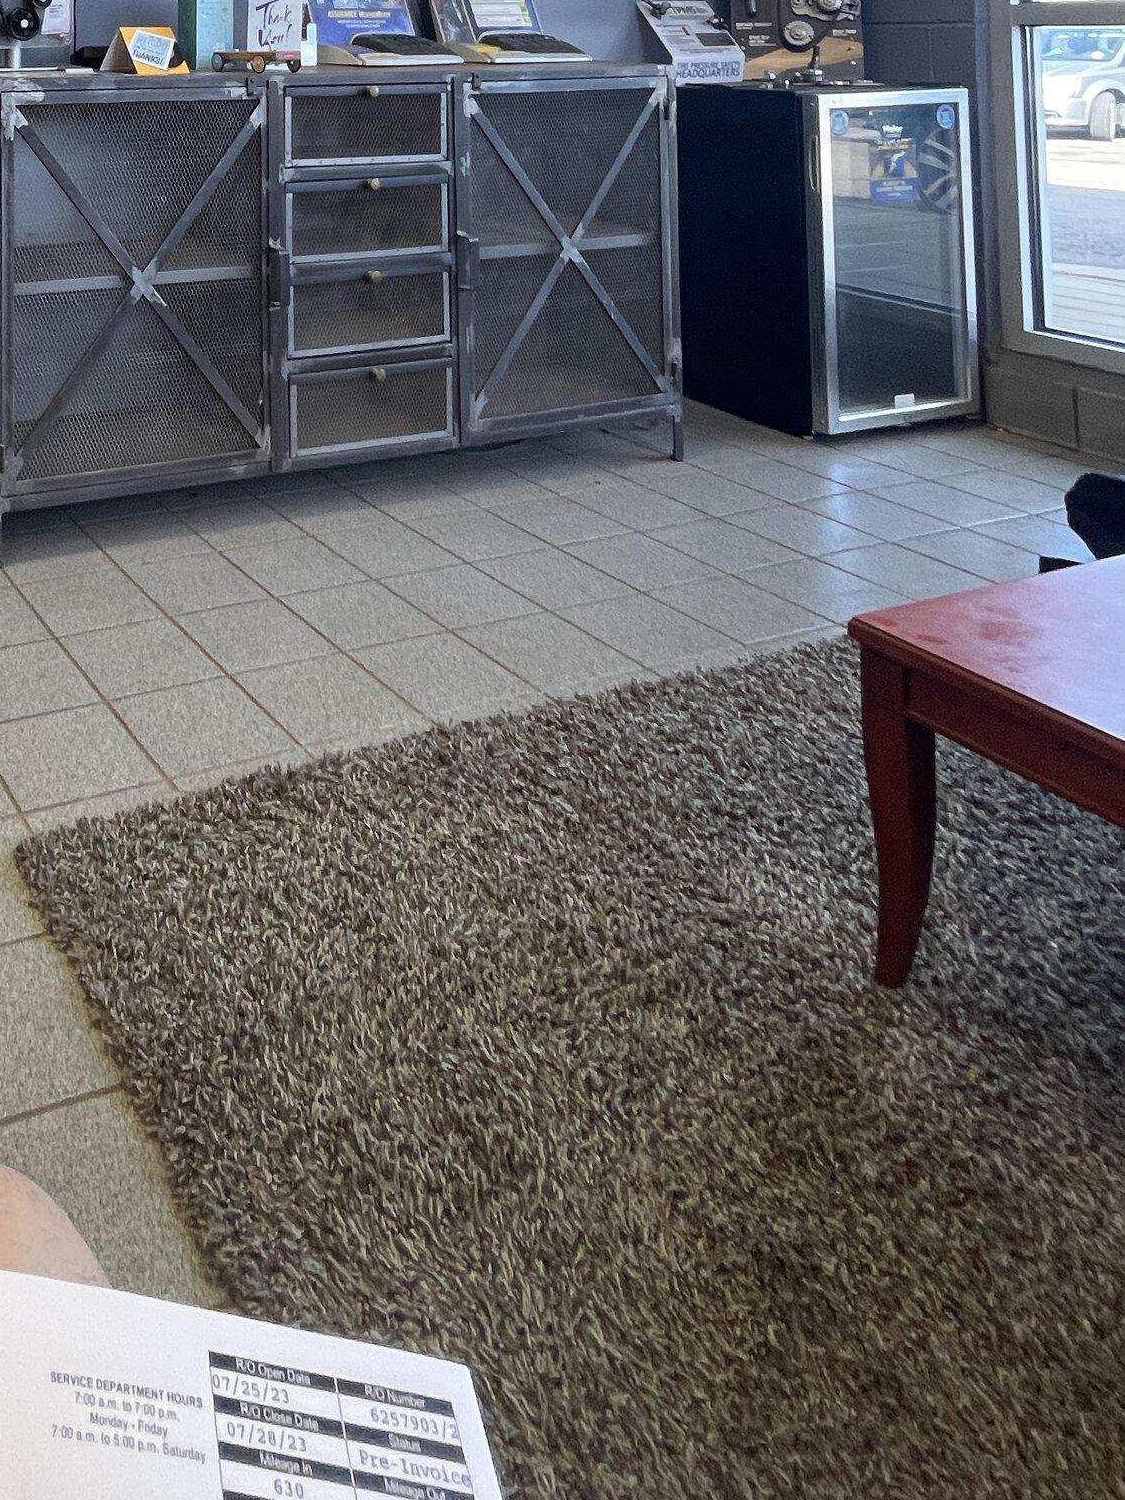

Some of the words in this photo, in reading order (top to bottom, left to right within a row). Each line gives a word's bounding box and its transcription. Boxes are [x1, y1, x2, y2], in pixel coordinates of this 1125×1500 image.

[675, 67, 741, 78] HEADQUARTERS
[50, 1371, 94, 1389] SERVICE
[96, 1378, 164, 1400] DEPARTMENT
[167, 1391, 203, 1408] HOURS
[212, 1373, 289, 1404] 07/25/23
[74, 1391, 96, 1406] 7:00
[122, 1400, 132, 1412] to
[135, 1401, 156, 1416] 7:00
[89, 1411, 128, 1433] Monday
[137, 1419, 168, 1439] Friday
[51, 1424, 74, 1439] 7:00
[101, 1432, 111, 1445] to
[162, 1442, 206, 1465] Saturday
[359, 1449, 472, 1488] Pre-Invoice
[274, 1478, 304, 1499] 630
